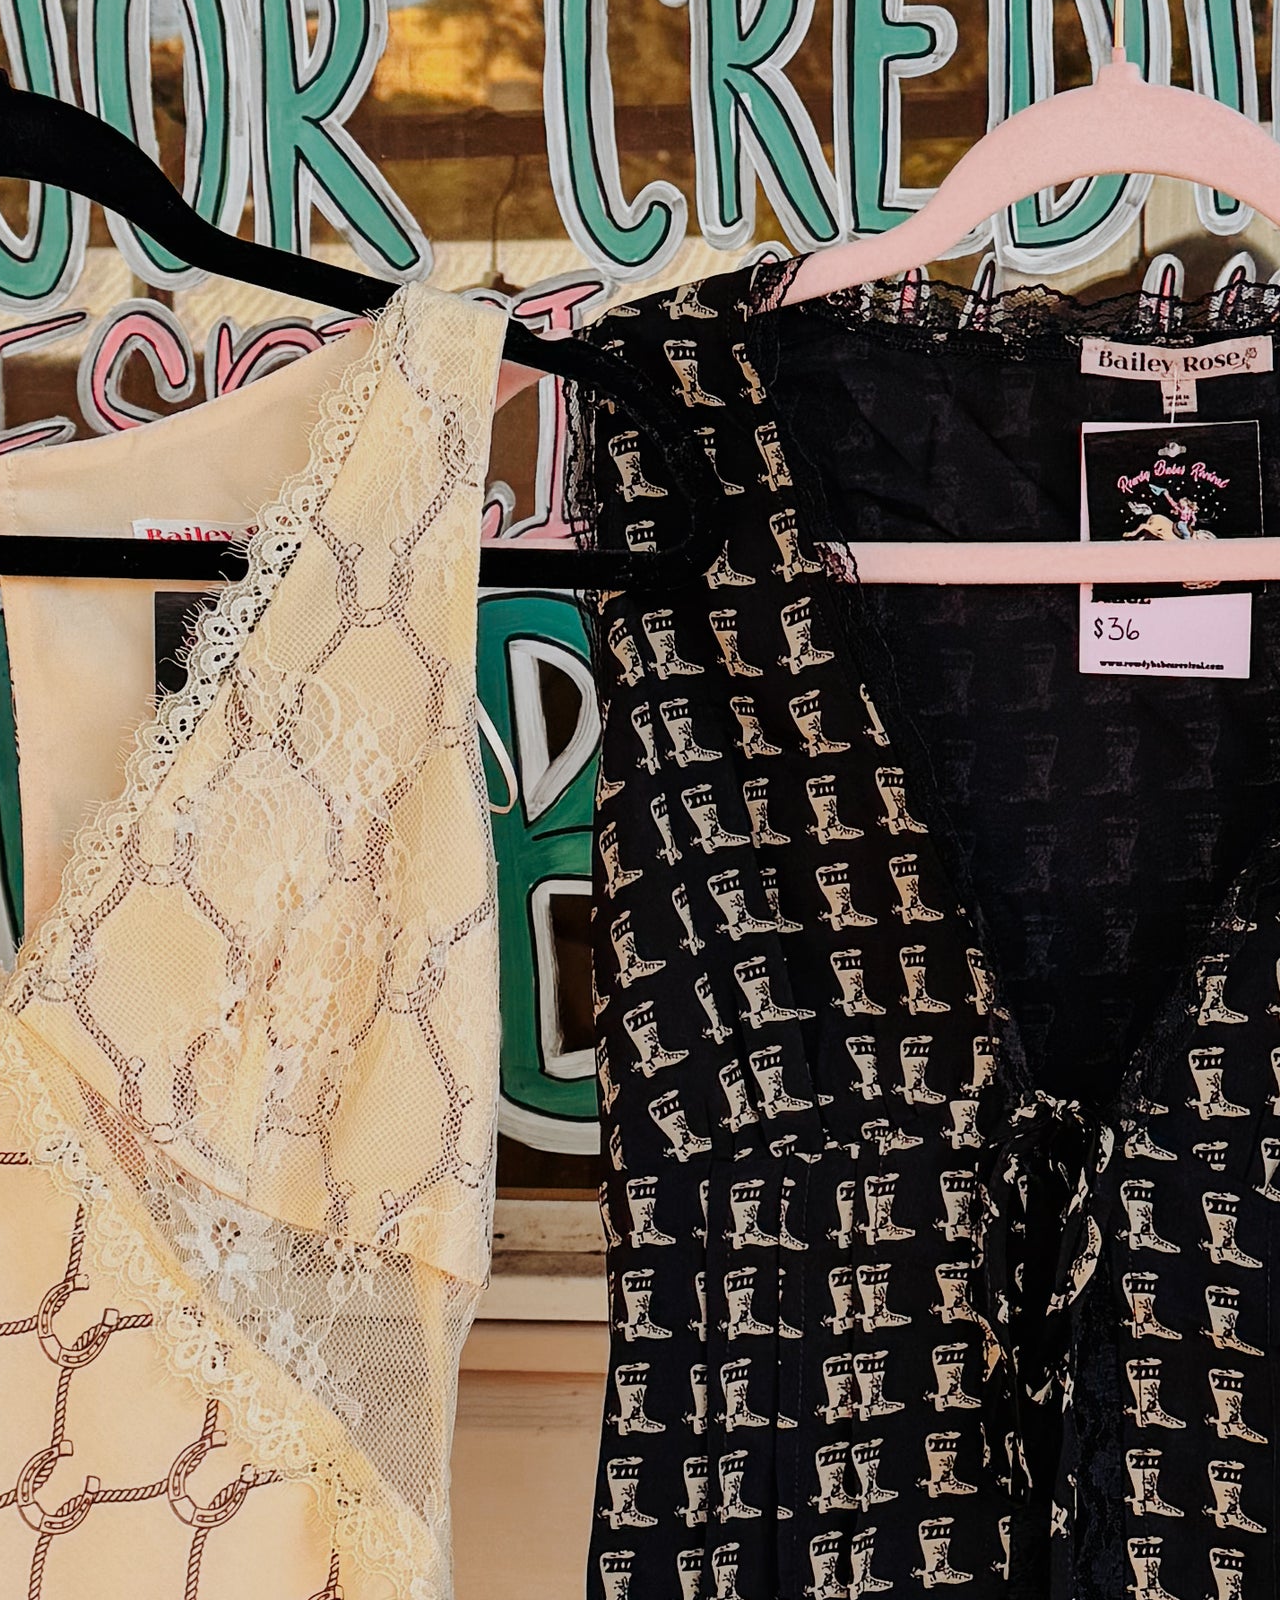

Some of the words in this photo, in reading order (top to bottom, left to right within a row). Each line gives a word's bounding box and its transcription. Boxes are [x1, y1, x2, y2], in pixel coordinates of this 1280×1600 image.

[1098, 349, 1174, 377] Bailey
[1183, 350, 1240, 372] Rose
[1093, 616, 1140, 641] $36
